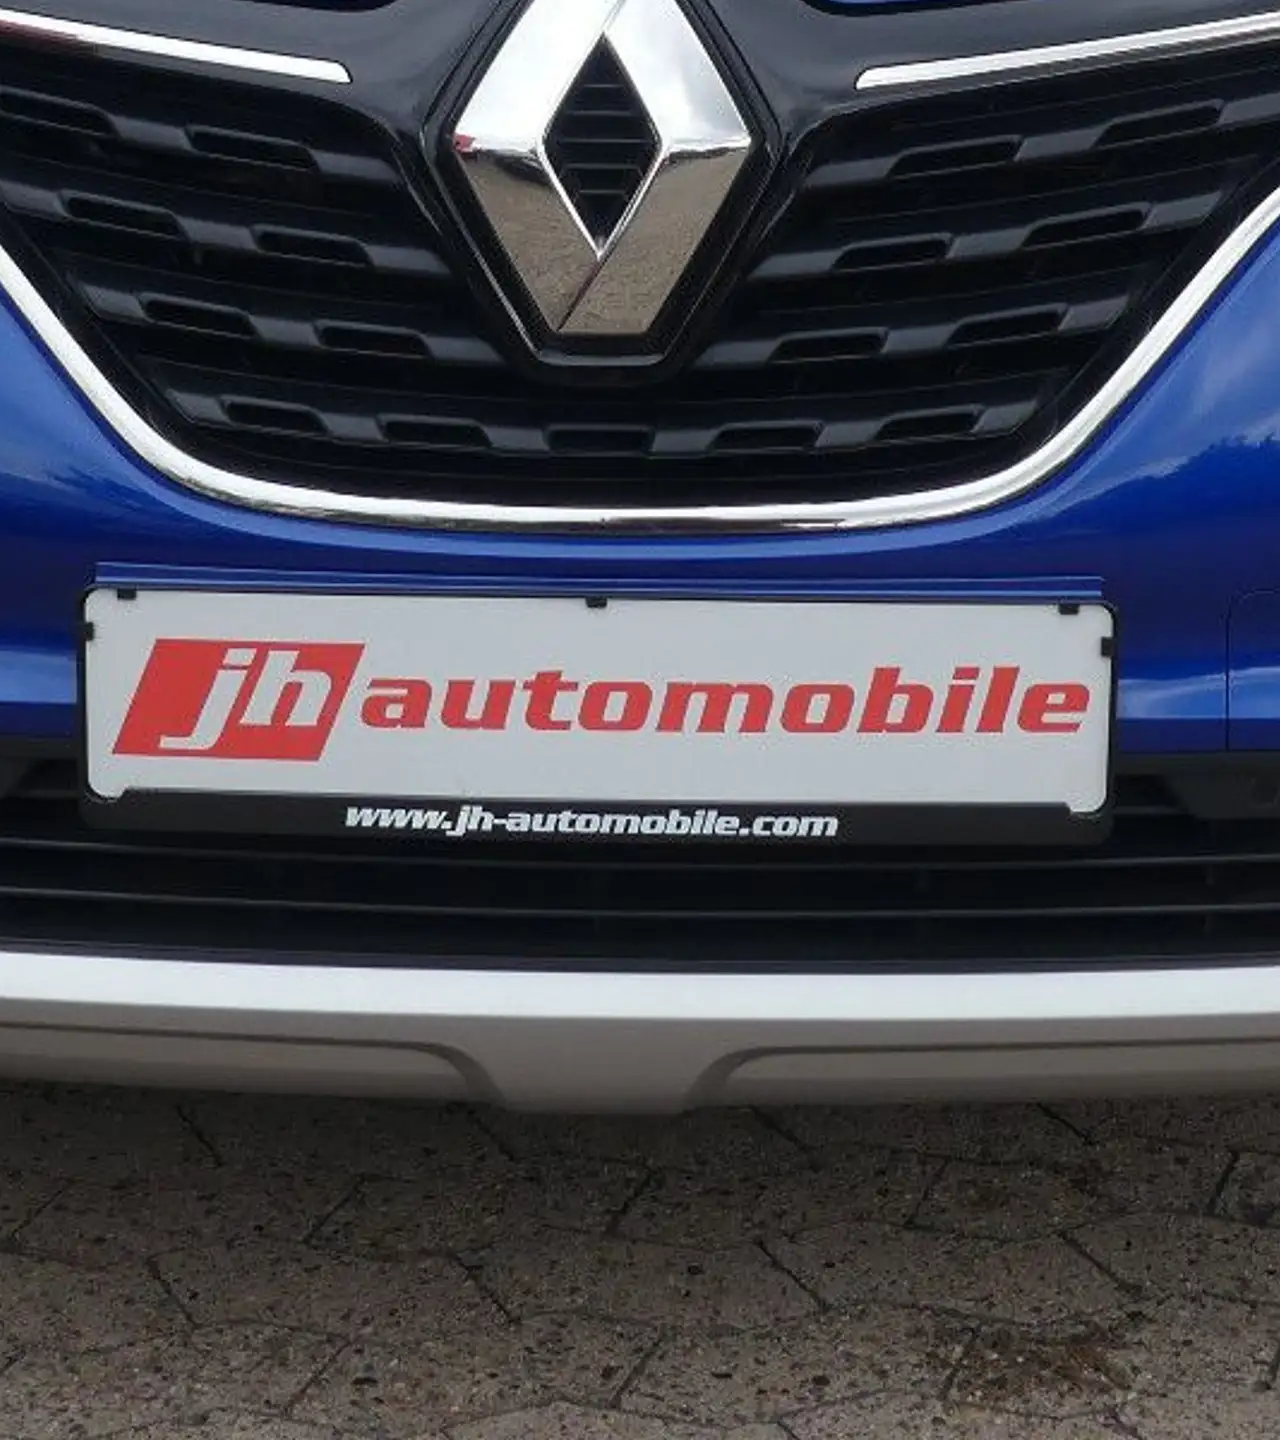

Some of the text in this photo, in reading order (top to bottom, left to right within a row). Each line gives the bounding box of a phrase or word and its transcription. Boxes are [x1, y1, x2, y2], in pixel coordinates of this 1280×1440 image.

[158, 647, 1091, 751] jh automobile
[344, 805, 839, 837] www.jh-automobile.com
